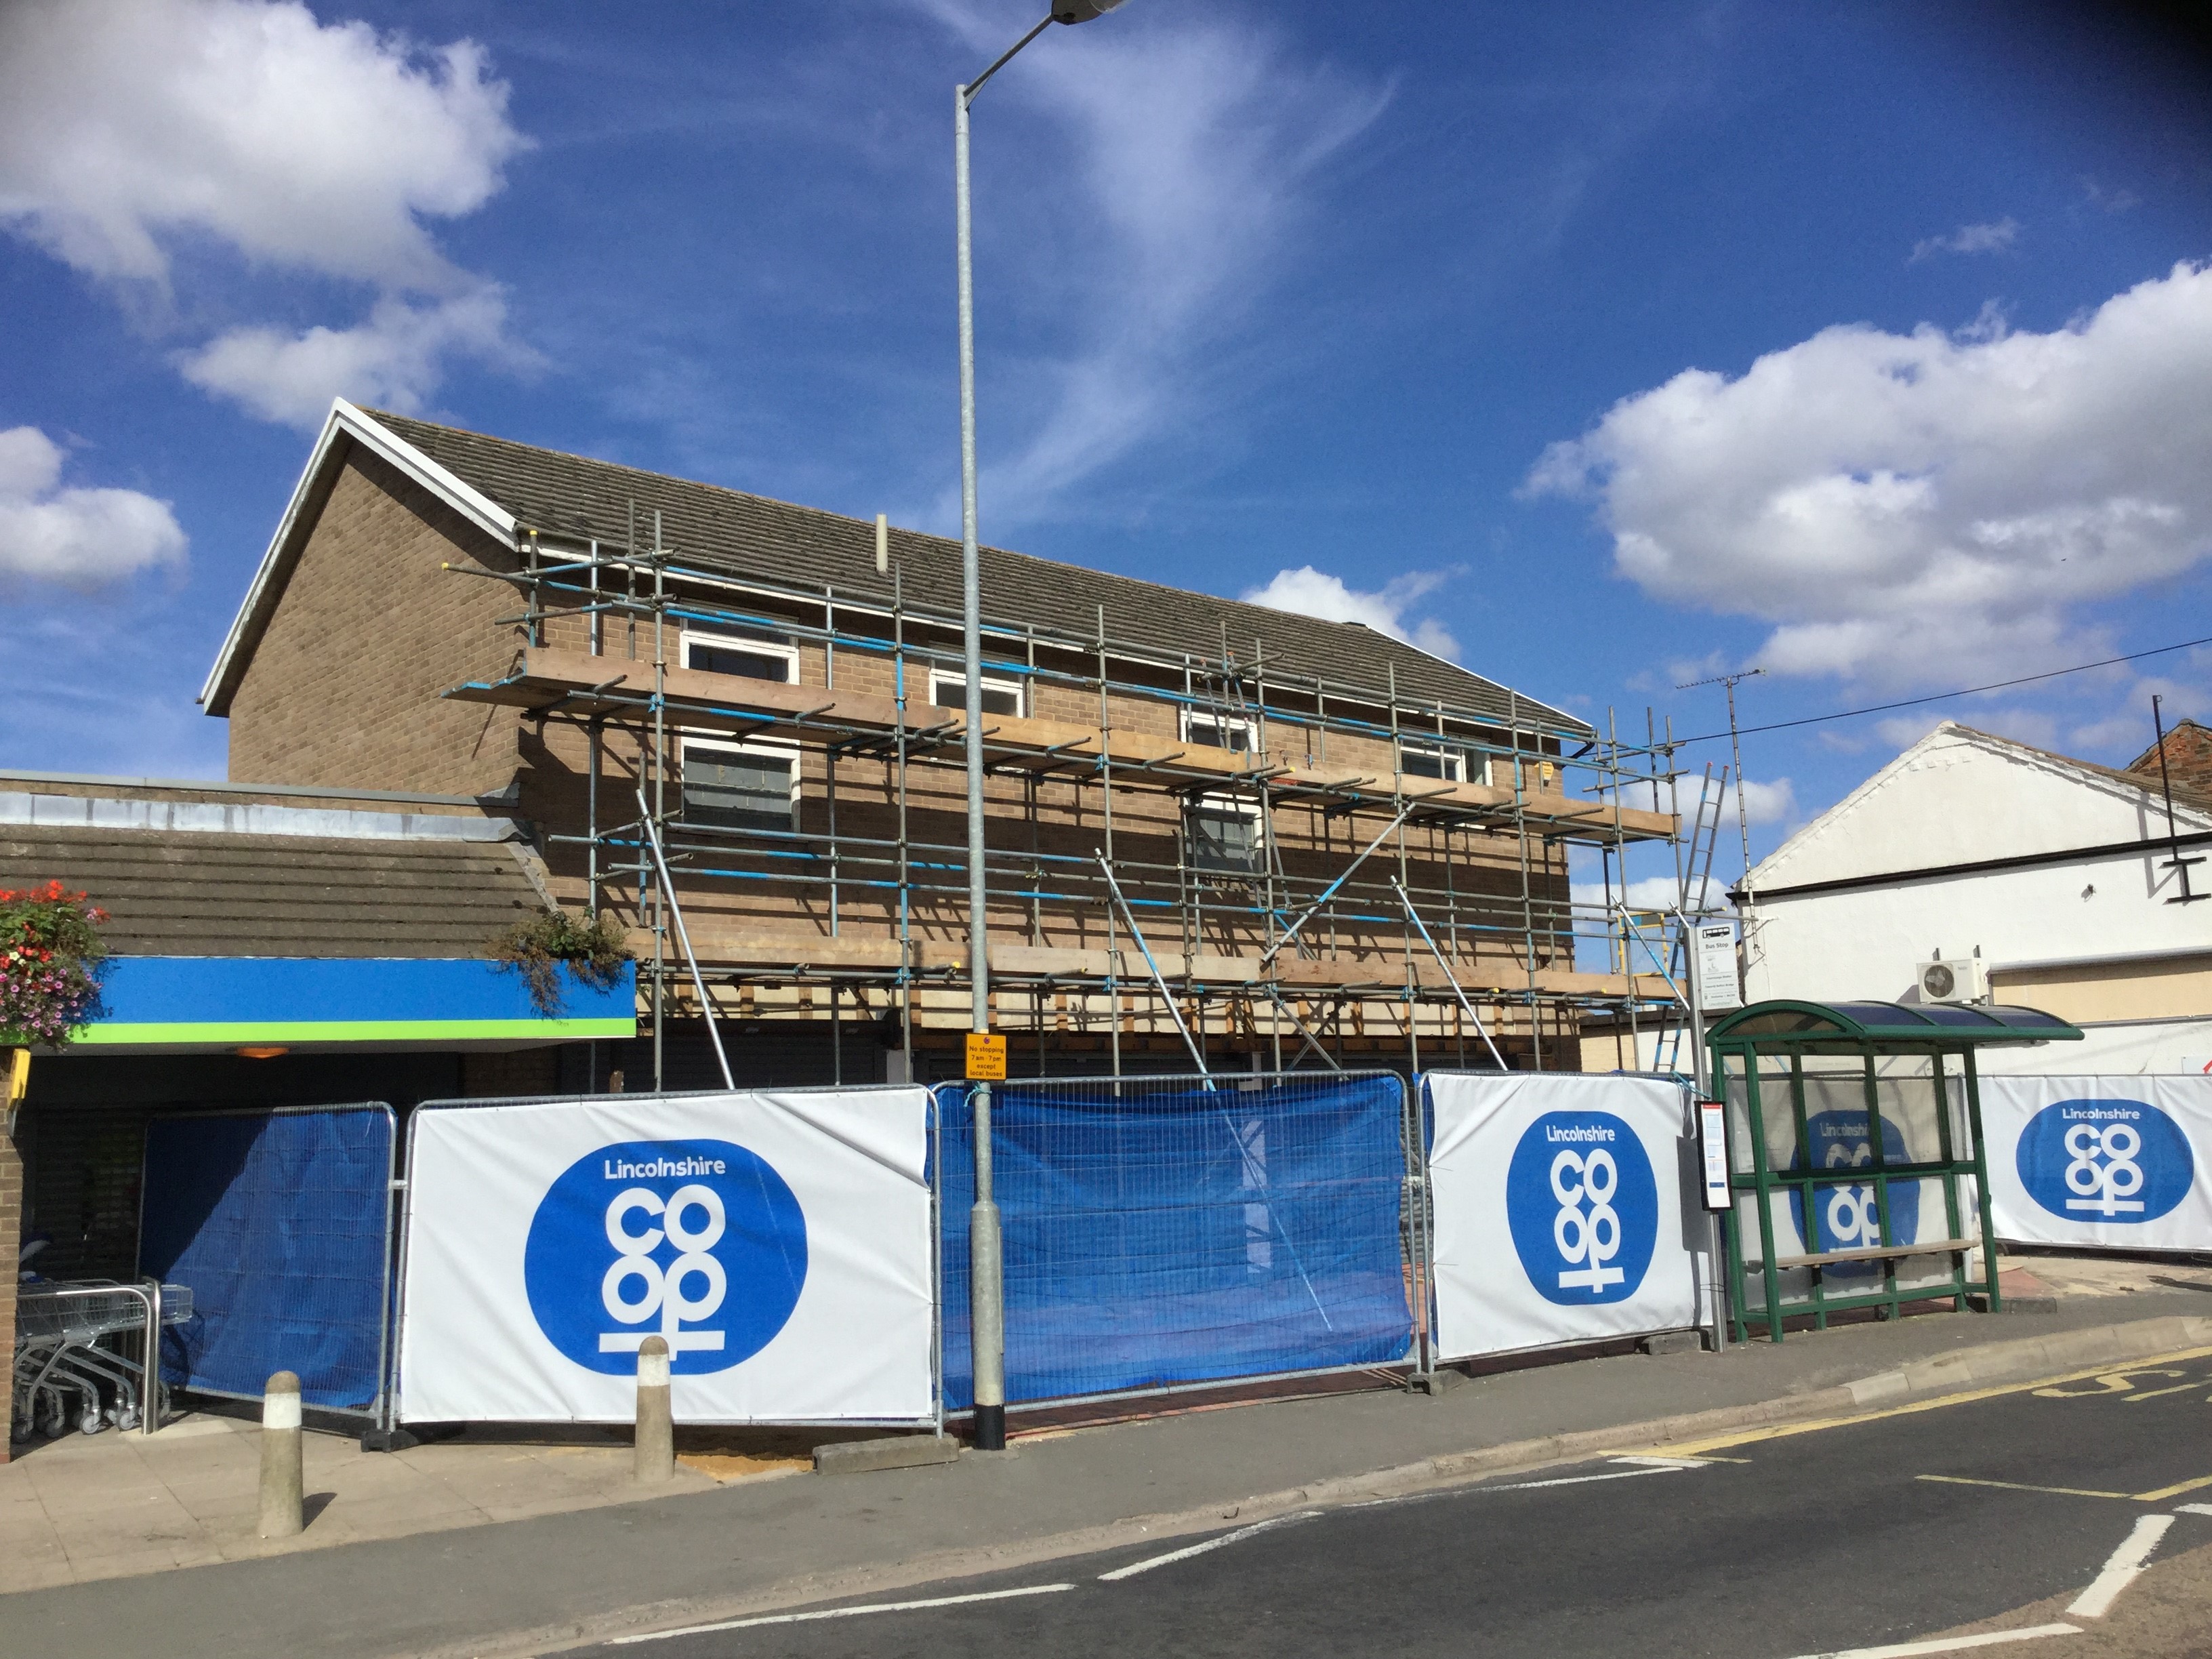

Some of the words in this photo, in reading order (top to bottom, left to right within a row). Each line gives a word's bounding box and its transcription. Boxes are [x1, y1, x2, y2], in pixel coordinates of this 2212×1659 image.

[2062, 1108, 2140, 1119] Lincolnshire
[1546, 1125, 1616, 1142] Lincolnshire
[605, 1156, 726, 1179] Lincolnshire
